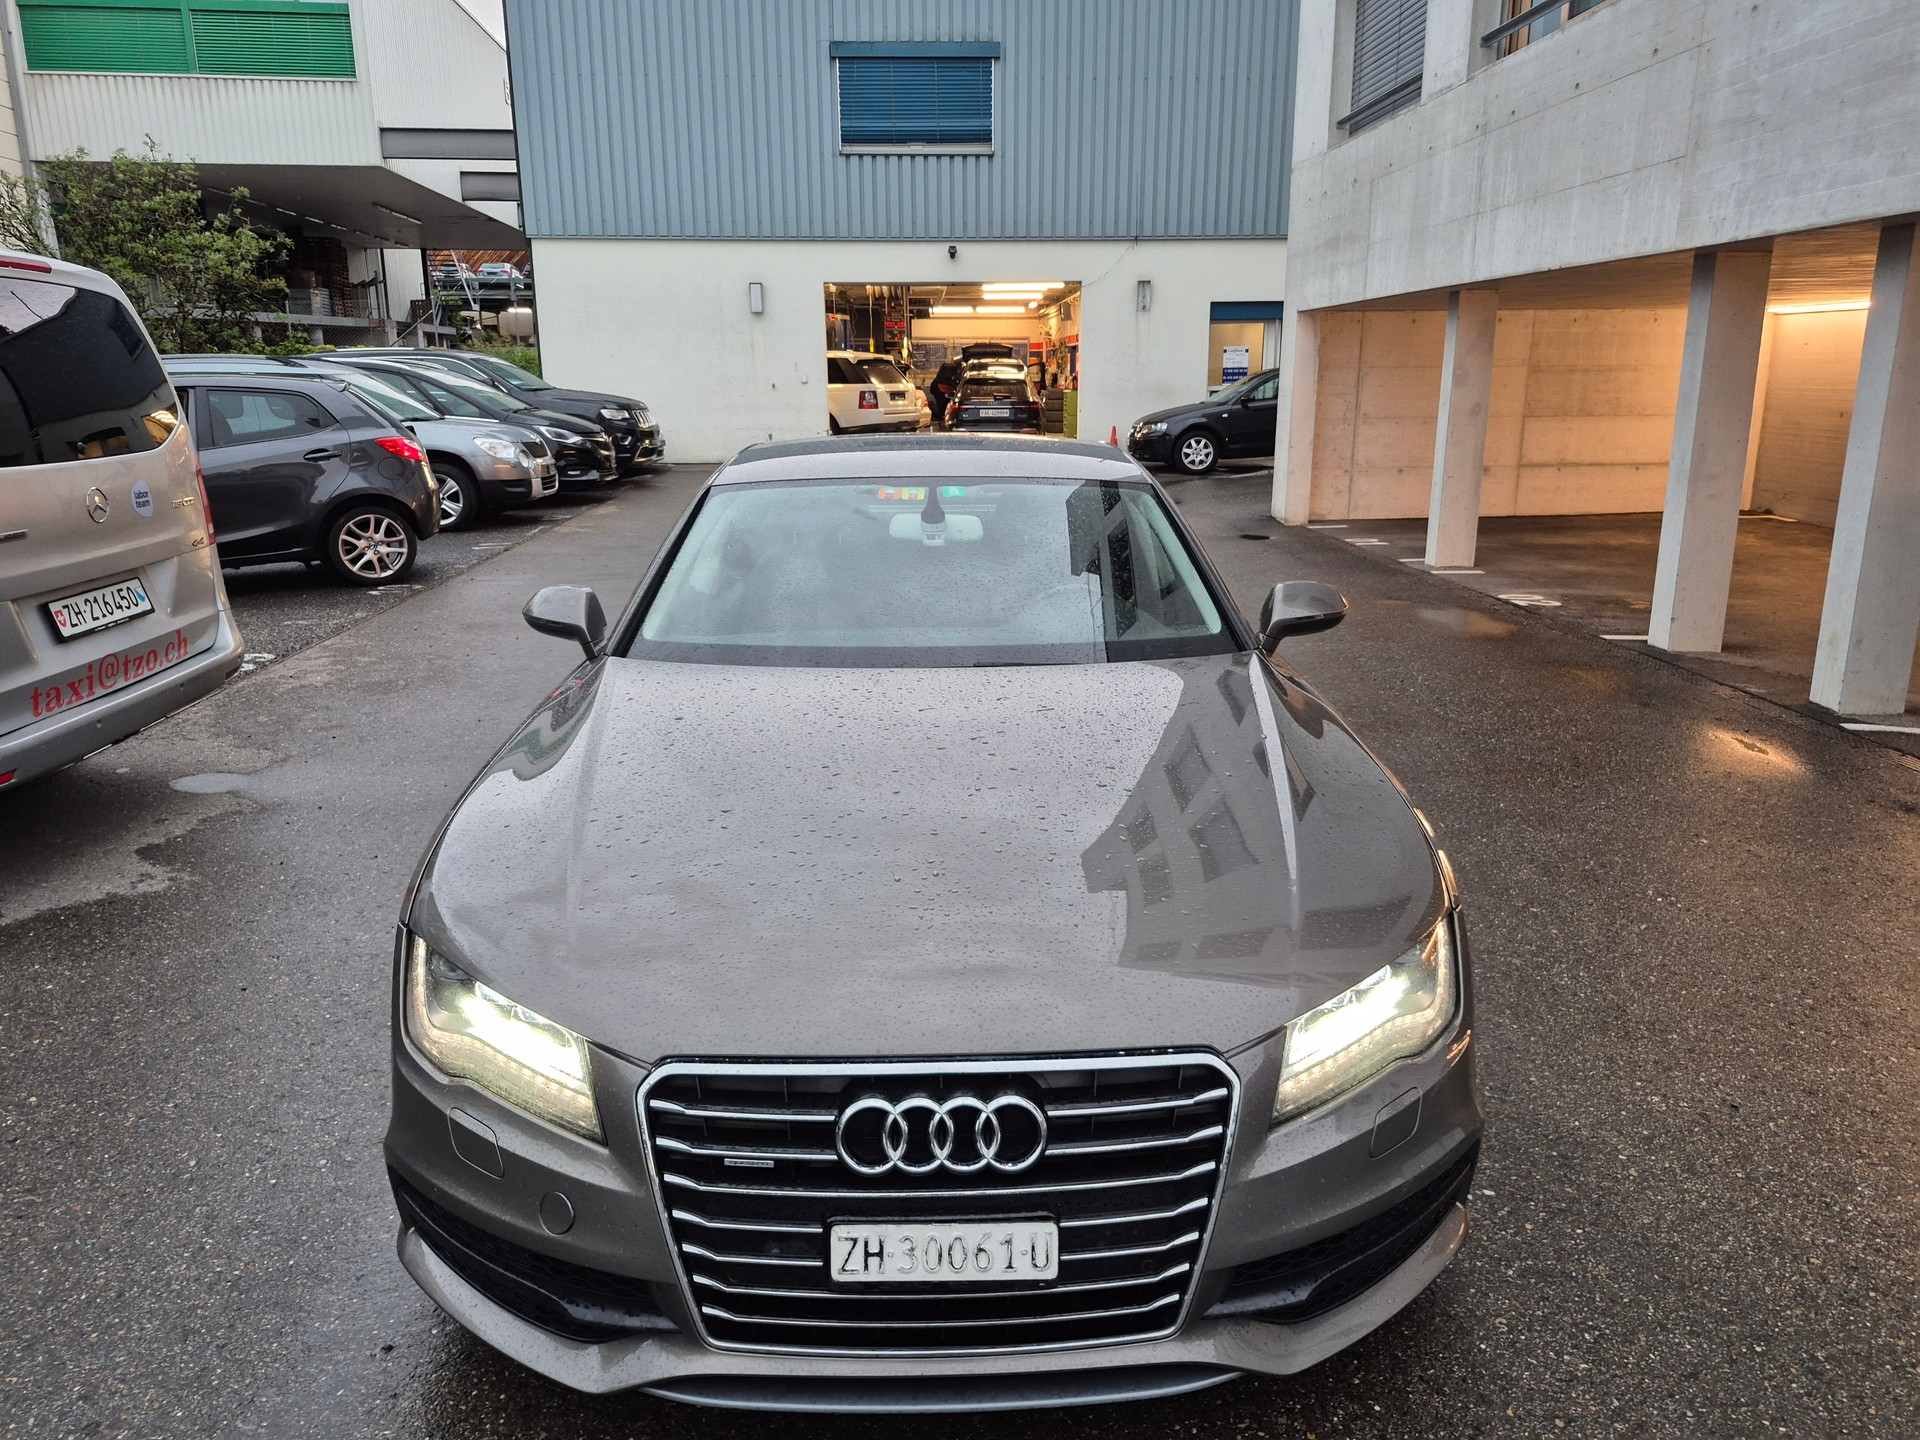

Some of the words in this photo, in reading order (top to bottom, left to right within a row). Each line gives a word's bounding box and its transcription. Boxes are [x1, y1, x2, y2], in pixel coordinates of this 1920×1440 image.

[133, 490, 149, 500] labor
[135, 499, 151, 509] team
[30, 629, 189, 718] taxi@tzo.ch
